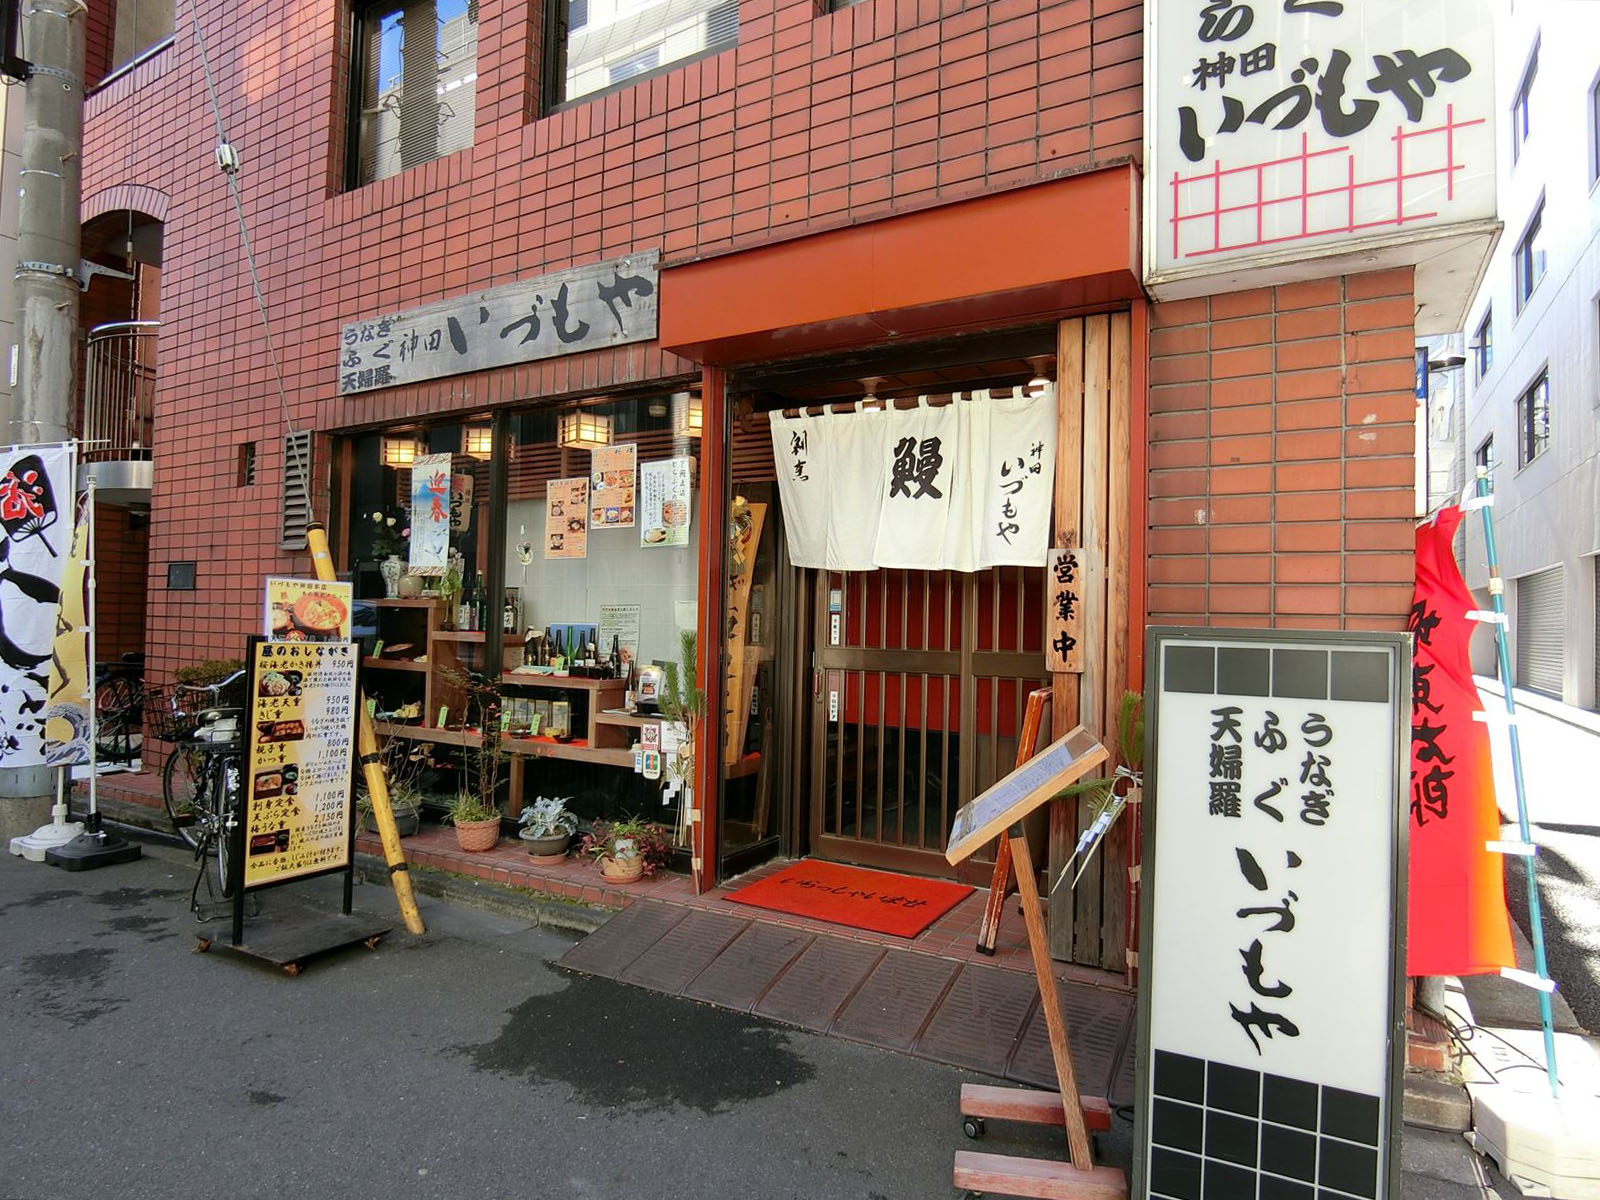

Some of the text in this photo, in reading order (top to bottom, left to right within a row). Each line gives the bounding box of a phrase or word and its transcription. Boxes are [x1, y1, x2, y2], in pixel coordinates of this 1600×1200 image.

[1190, 43, 1277, 90] 神田
[1178, 47, 1472, 163] いづもや
[344, 315, 404, 346] うなぎ
[399, 272, 655, 362] 神田 いづもや
[342, 340, 394, 367] ふぐ
[341, 364, 397, 393] 天婦羅
[889, 436, 944, 500] 鰻
[1029, 441, 1045, 475] 神田
[996, 457, 1028, 545] いづもや
[1053, 554, 1079, 663] 営業中
[262, 645, 349, 657] 昼のおしながき
[333, 659, 354, 668] 950円
[258, 695, 350, 708] 海老天重 950円
[259, 706, 349, 720] きじ重 980円
[256, 738, 349, 753] 親子重 800円
[257, 748, 347, 764] かつ重 1,100円
[1208, 706, 1244, 819] 天婦羅
[1254, 711, 1289, 824] ふぐ
[1300, 713, 1335, 827] うなぎ
[316, 790, 344, 802] 1,100円
[253, 801, 343, 822] 天ぷら定食 1,200円
[314, 811, 343, 823] 2,150円
[780, 878, 928, 908] いらっしゃいませ
[1228, 846, 1303, 1057] いづもや
